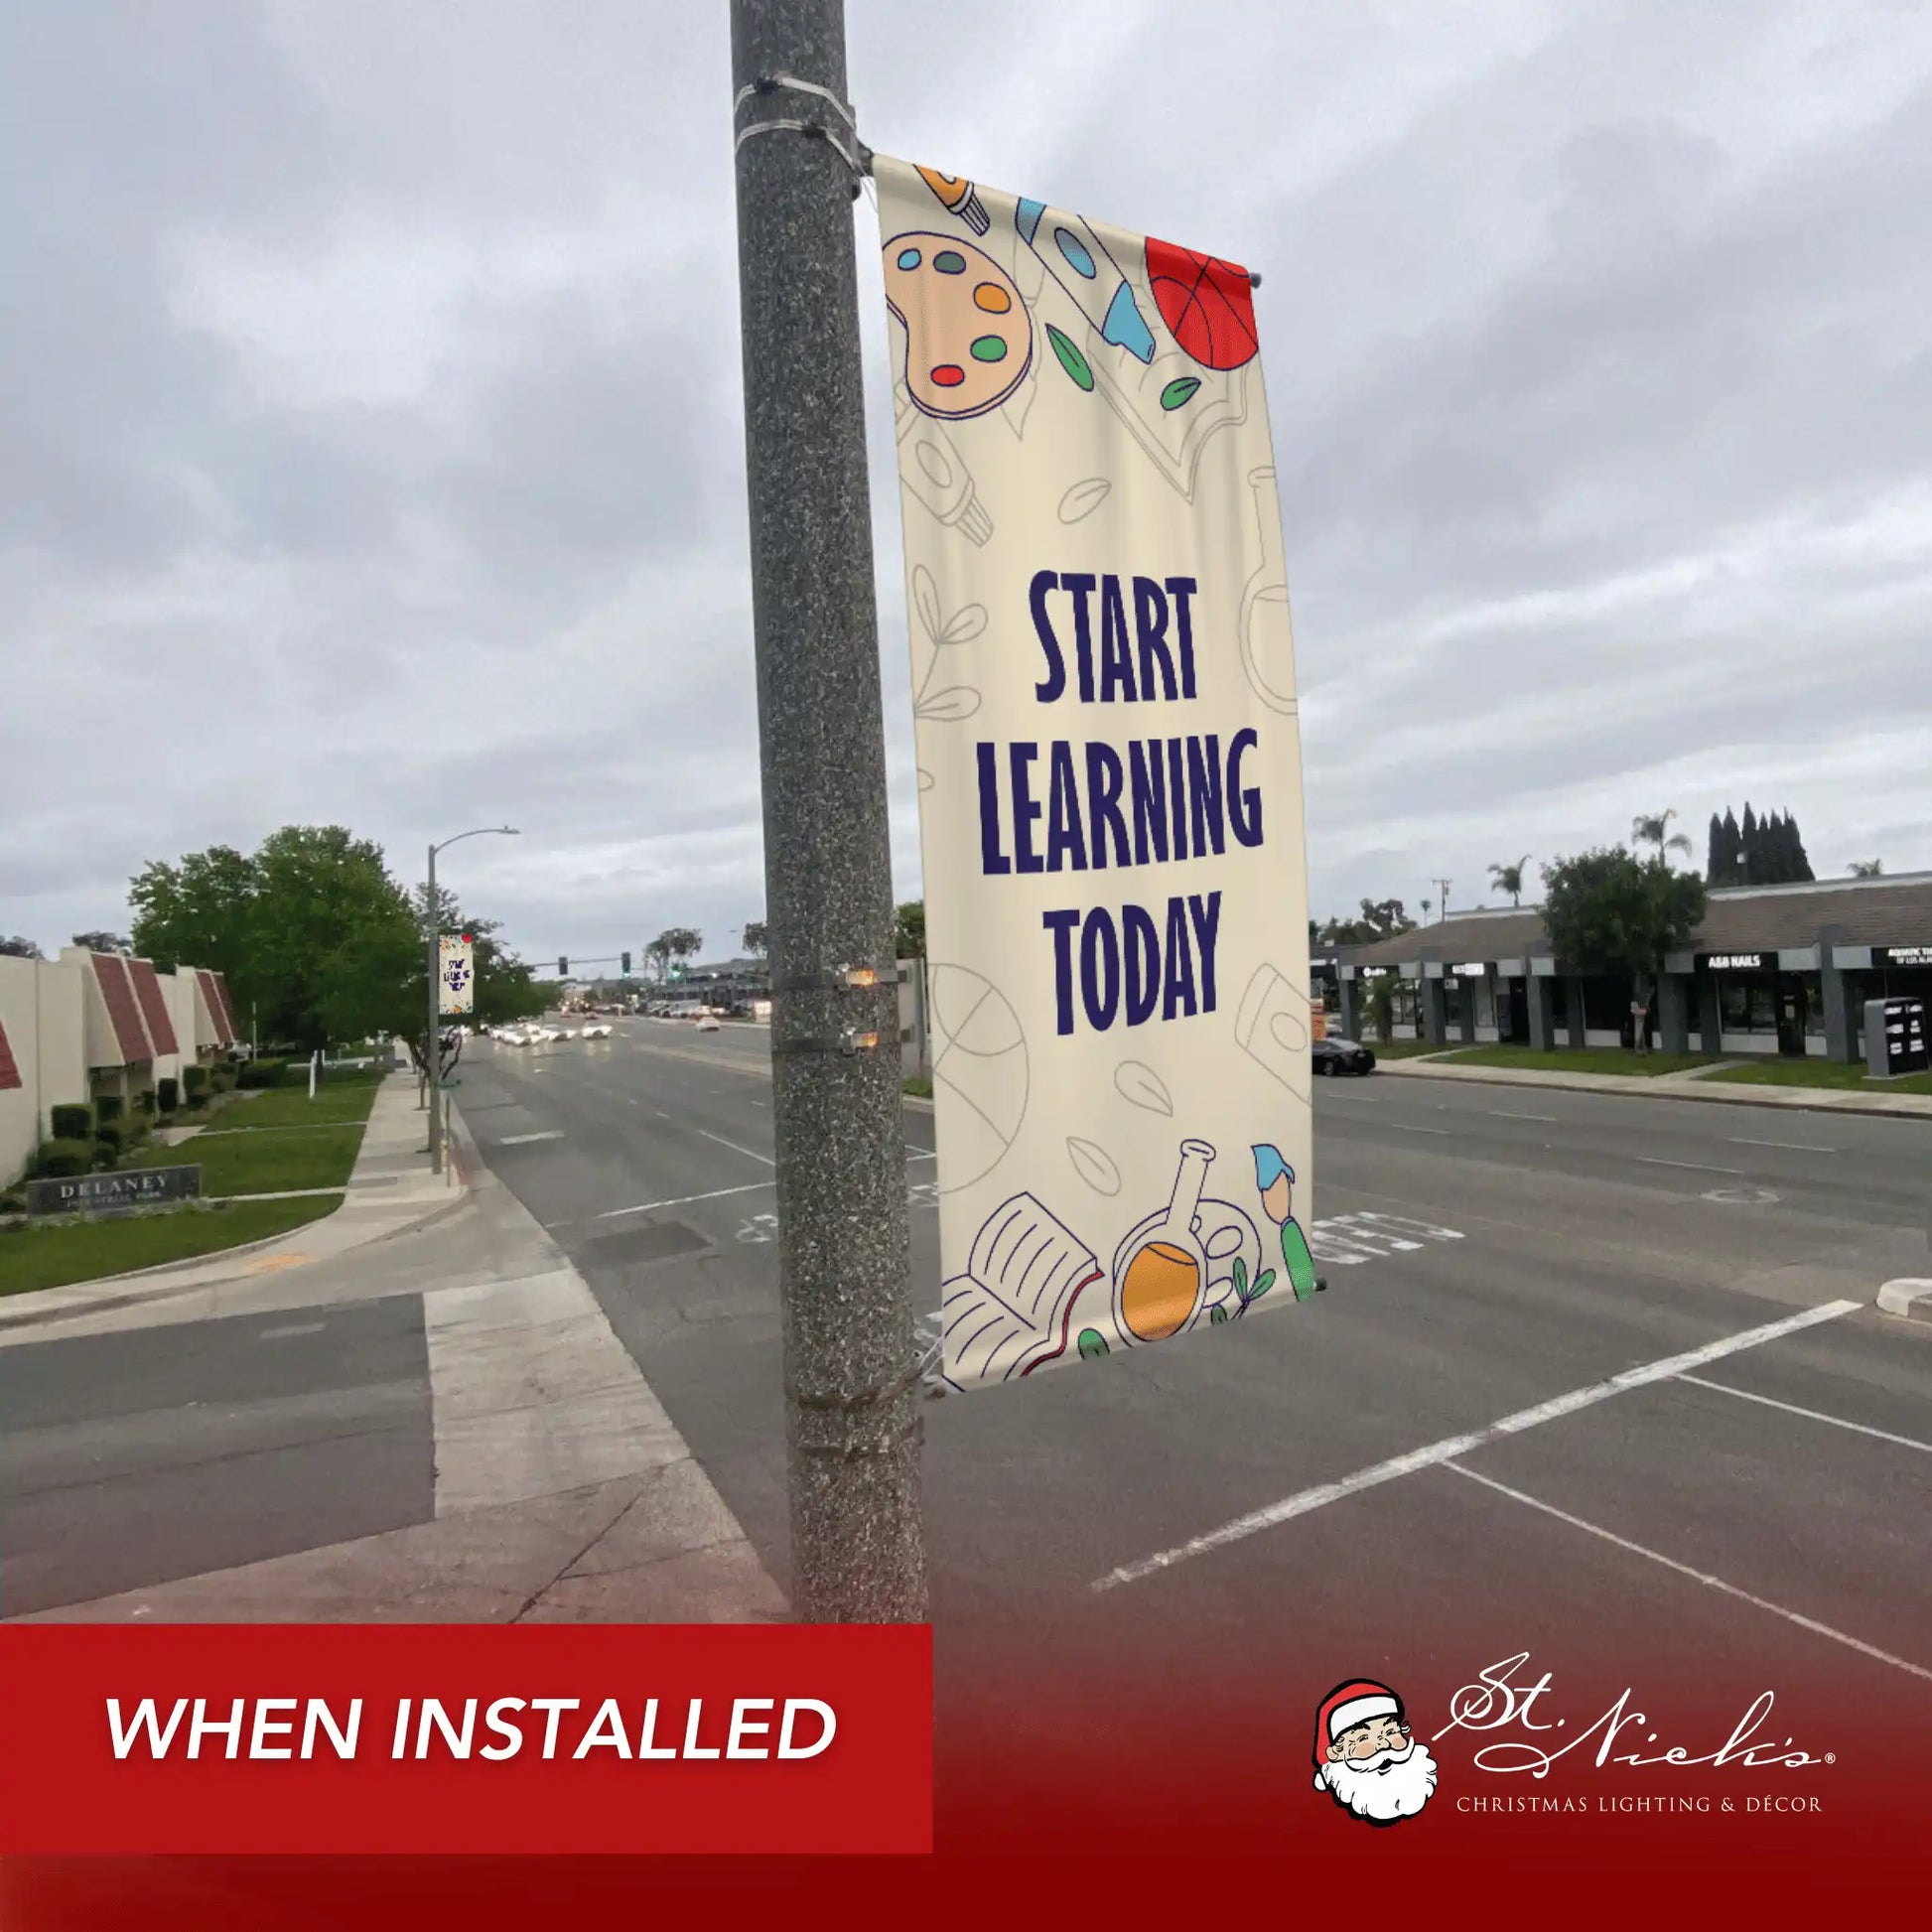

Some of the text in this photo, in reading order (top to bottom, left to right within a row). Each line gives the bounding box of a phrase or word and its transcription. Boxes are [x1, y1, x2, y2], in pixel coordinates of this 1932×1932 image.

[1030, 570, 1197, 703] START
[977, 728, 1264, 876] LEARNING
[1042, 891, 1222, 1035] TODAY
[1730, 954, 1760, 968] NAILS
[61, 1175, 167, 1198] DELANEY
